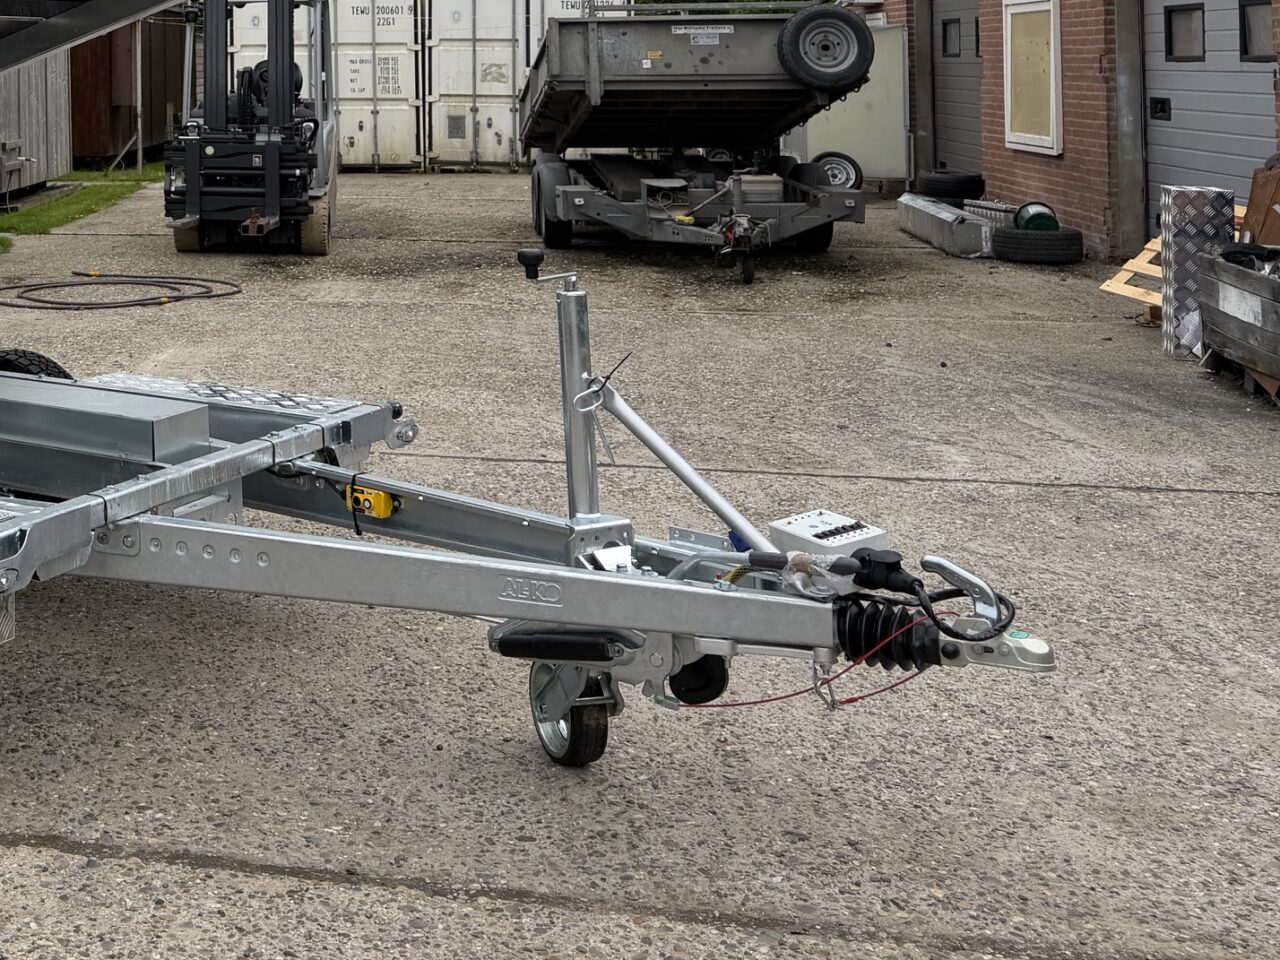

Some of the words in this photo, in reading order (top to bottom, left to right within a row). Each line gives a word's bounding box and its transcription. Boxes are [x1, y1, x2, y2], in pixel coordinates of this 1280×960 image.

[561, 0, 580, 10] TEWU
[351, 6, 370, 16] TEWU
[376, 5, 404, 16] 200601
[376, 17, 395, 27] 22G1
[500, 576, 562, 602] AL-KO
